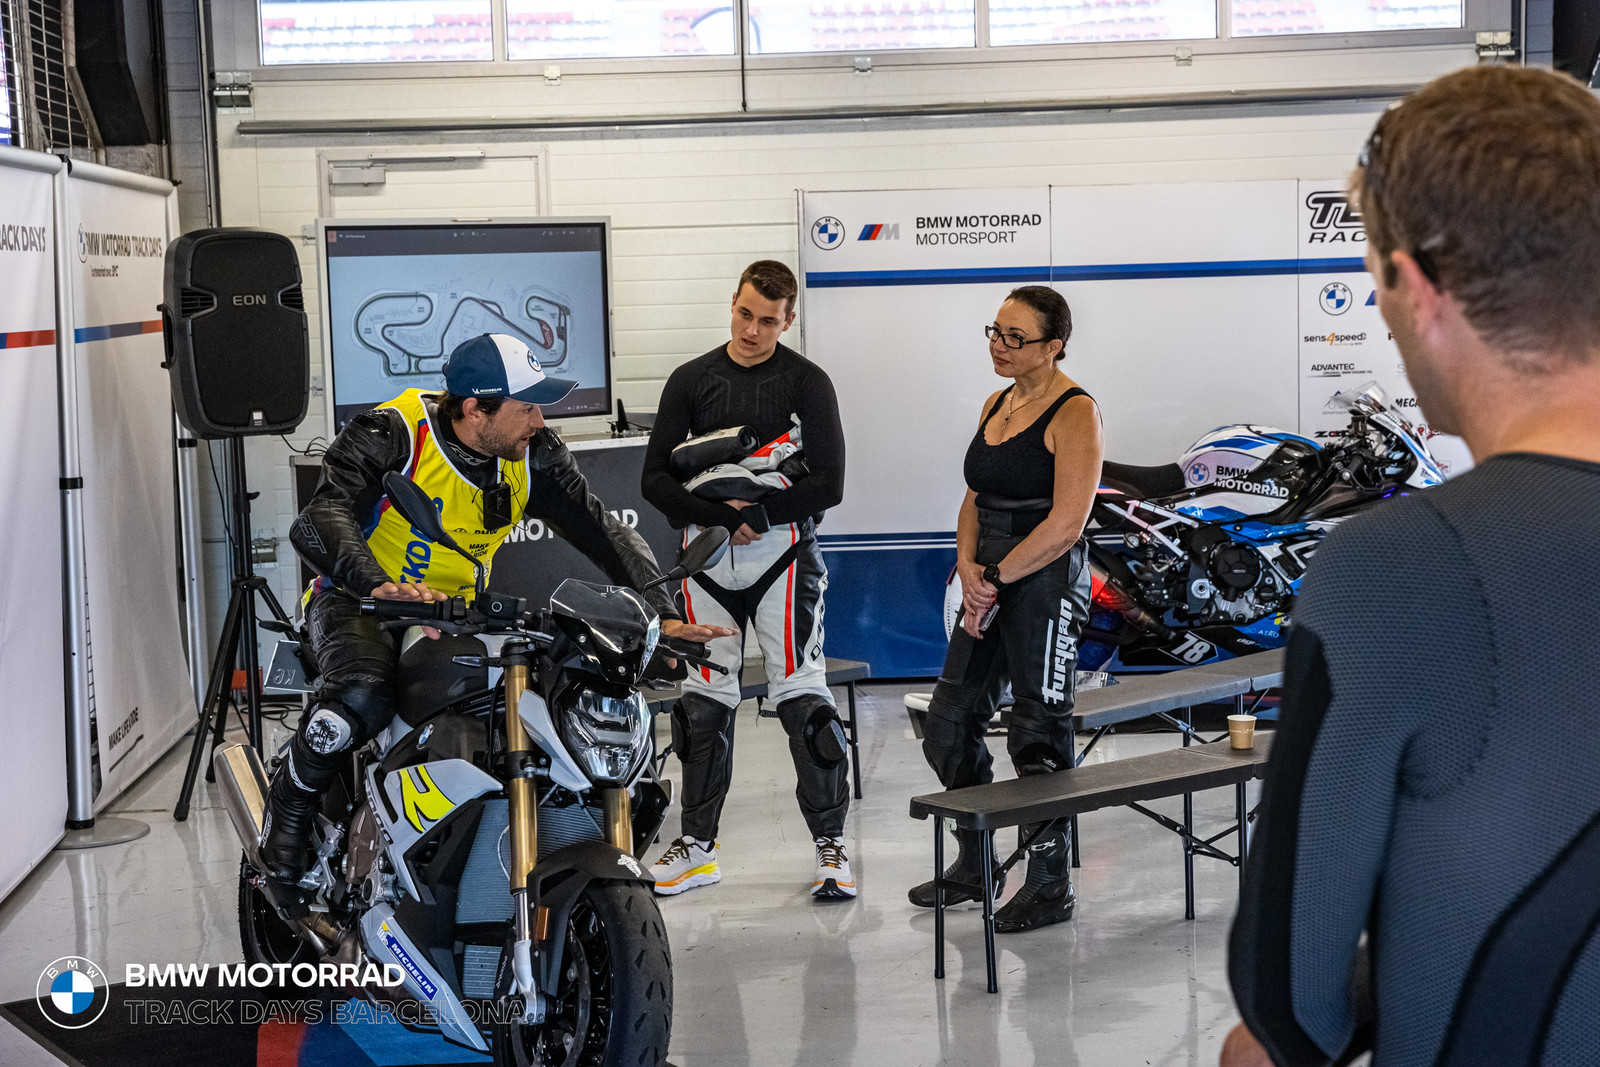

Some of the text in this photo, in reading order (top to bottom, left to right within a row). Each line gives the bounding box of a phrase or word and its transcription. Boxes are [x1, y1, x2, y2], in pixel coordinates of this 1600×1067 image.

[916, 214, 1042, 229] BMW MOTORRAD
[21, 226, 46, 252] DAYS
[100, 233, 131, 257] MOTORRAD
[132, 236, 149, 258] TRACK
[149, 237, 162, 258] DAYS
[916, 231, 1017, 246] MOTORSPORT
[232, 294, 267, 306] EON
[1310, 362, 1355, 372] ADVANTEC
[1215, 465, 1250, 479] BMW
[1213, 477, 1290, 498] MOTORRAD
[1171, 632, 1211, 664] 78
[391, 943, 434, 994] MICHELIN
